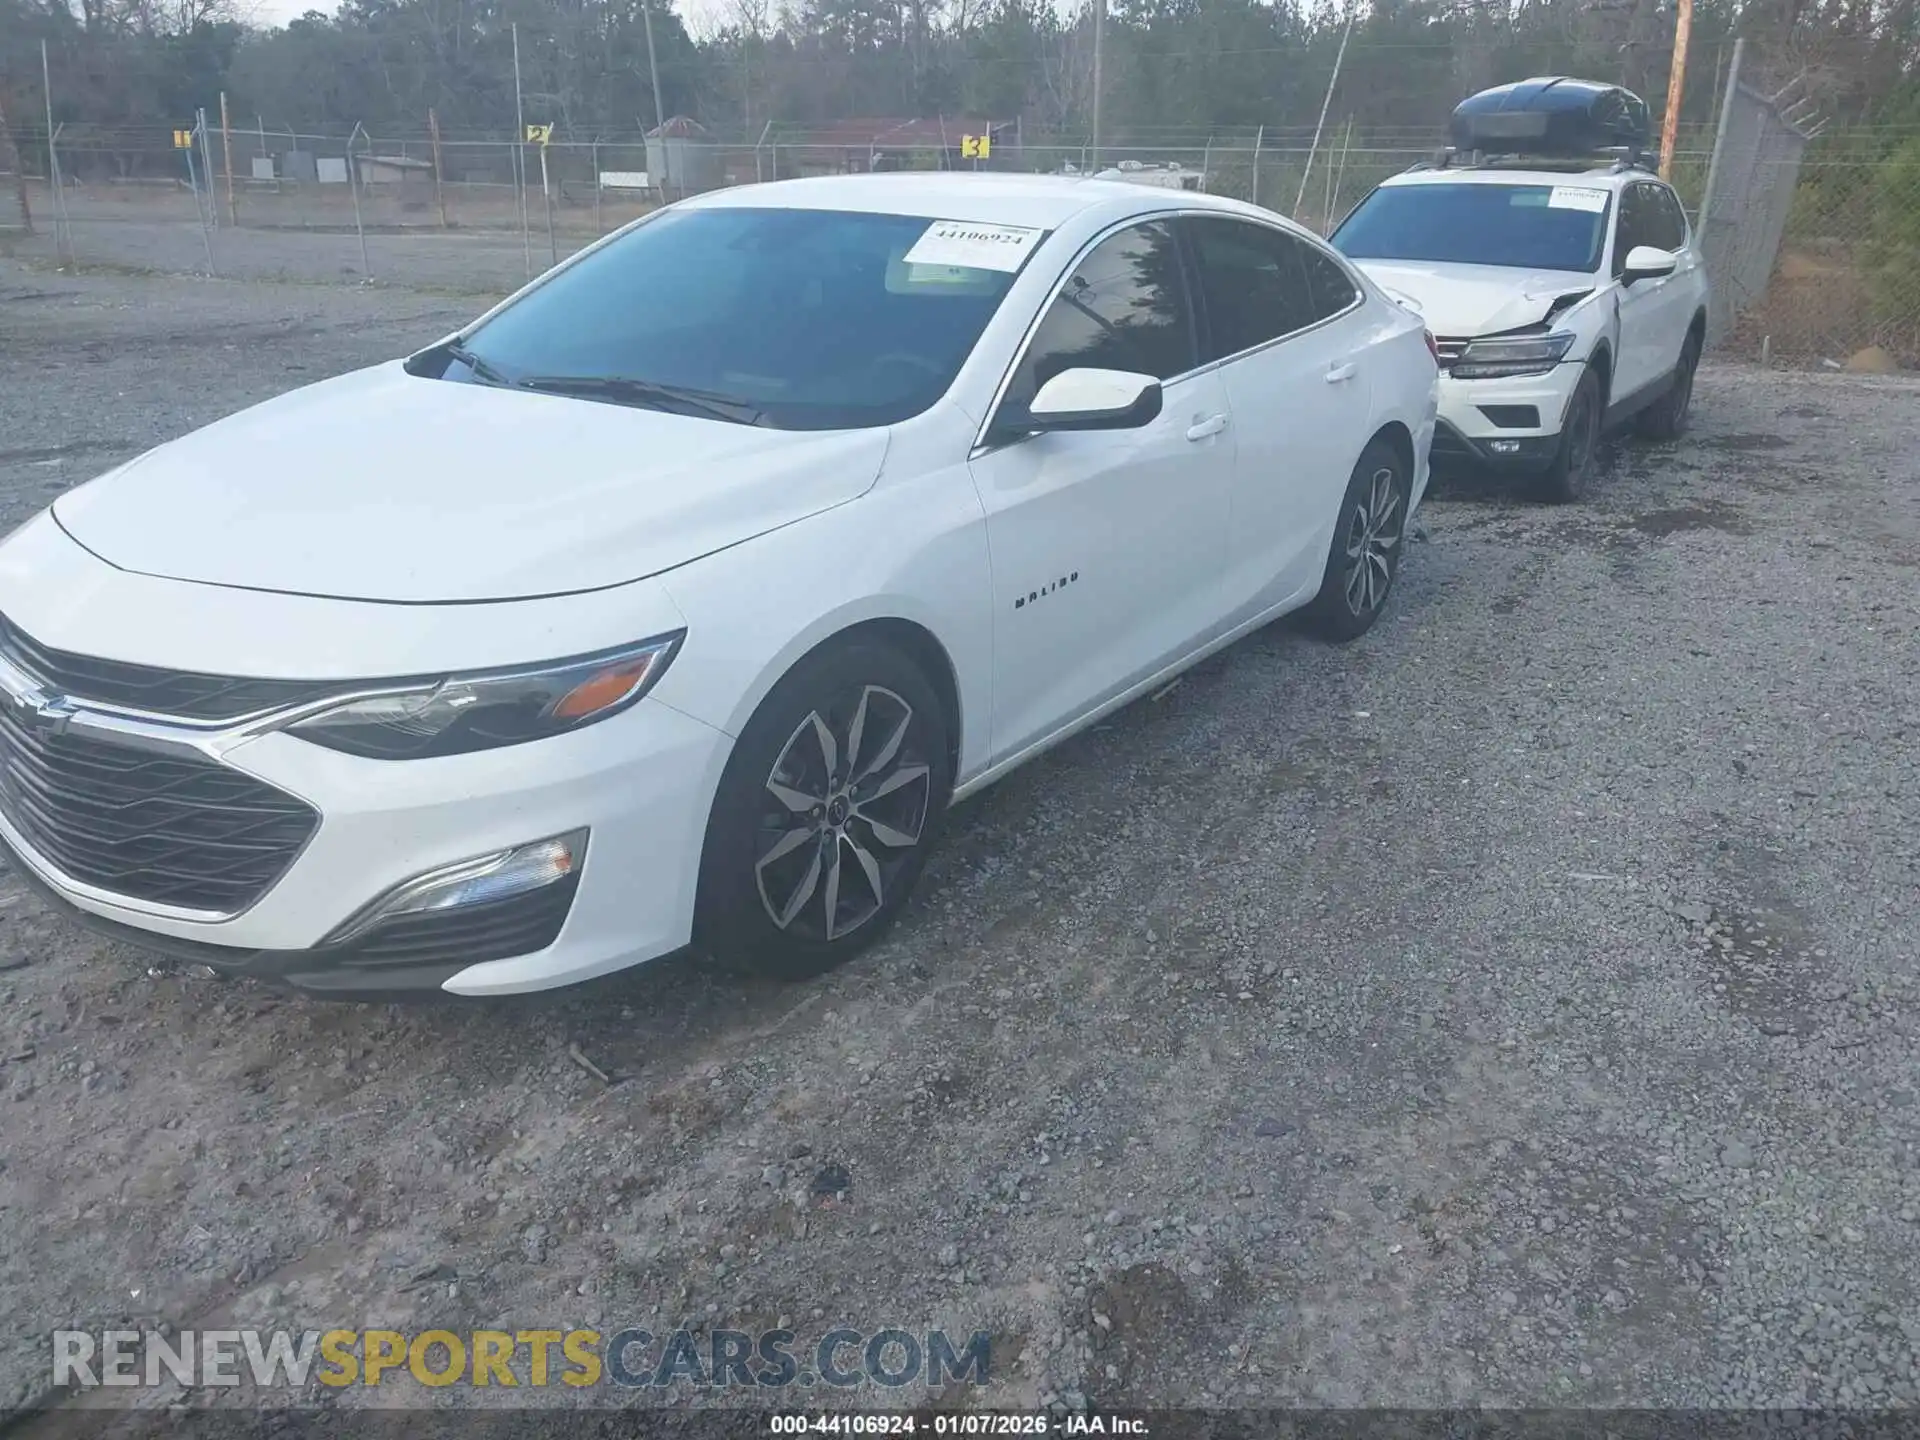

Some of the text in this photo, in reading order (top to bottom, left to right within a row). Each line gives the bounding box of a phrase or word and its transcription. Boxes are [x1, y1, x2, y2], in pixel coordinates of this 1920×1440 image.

[529, 126, 544, 144] 2
[967, 136, 981, 157] 3
[935, 230, 1024, 245] 44106924
[1015, 571, 1079, 609] MALIBU
